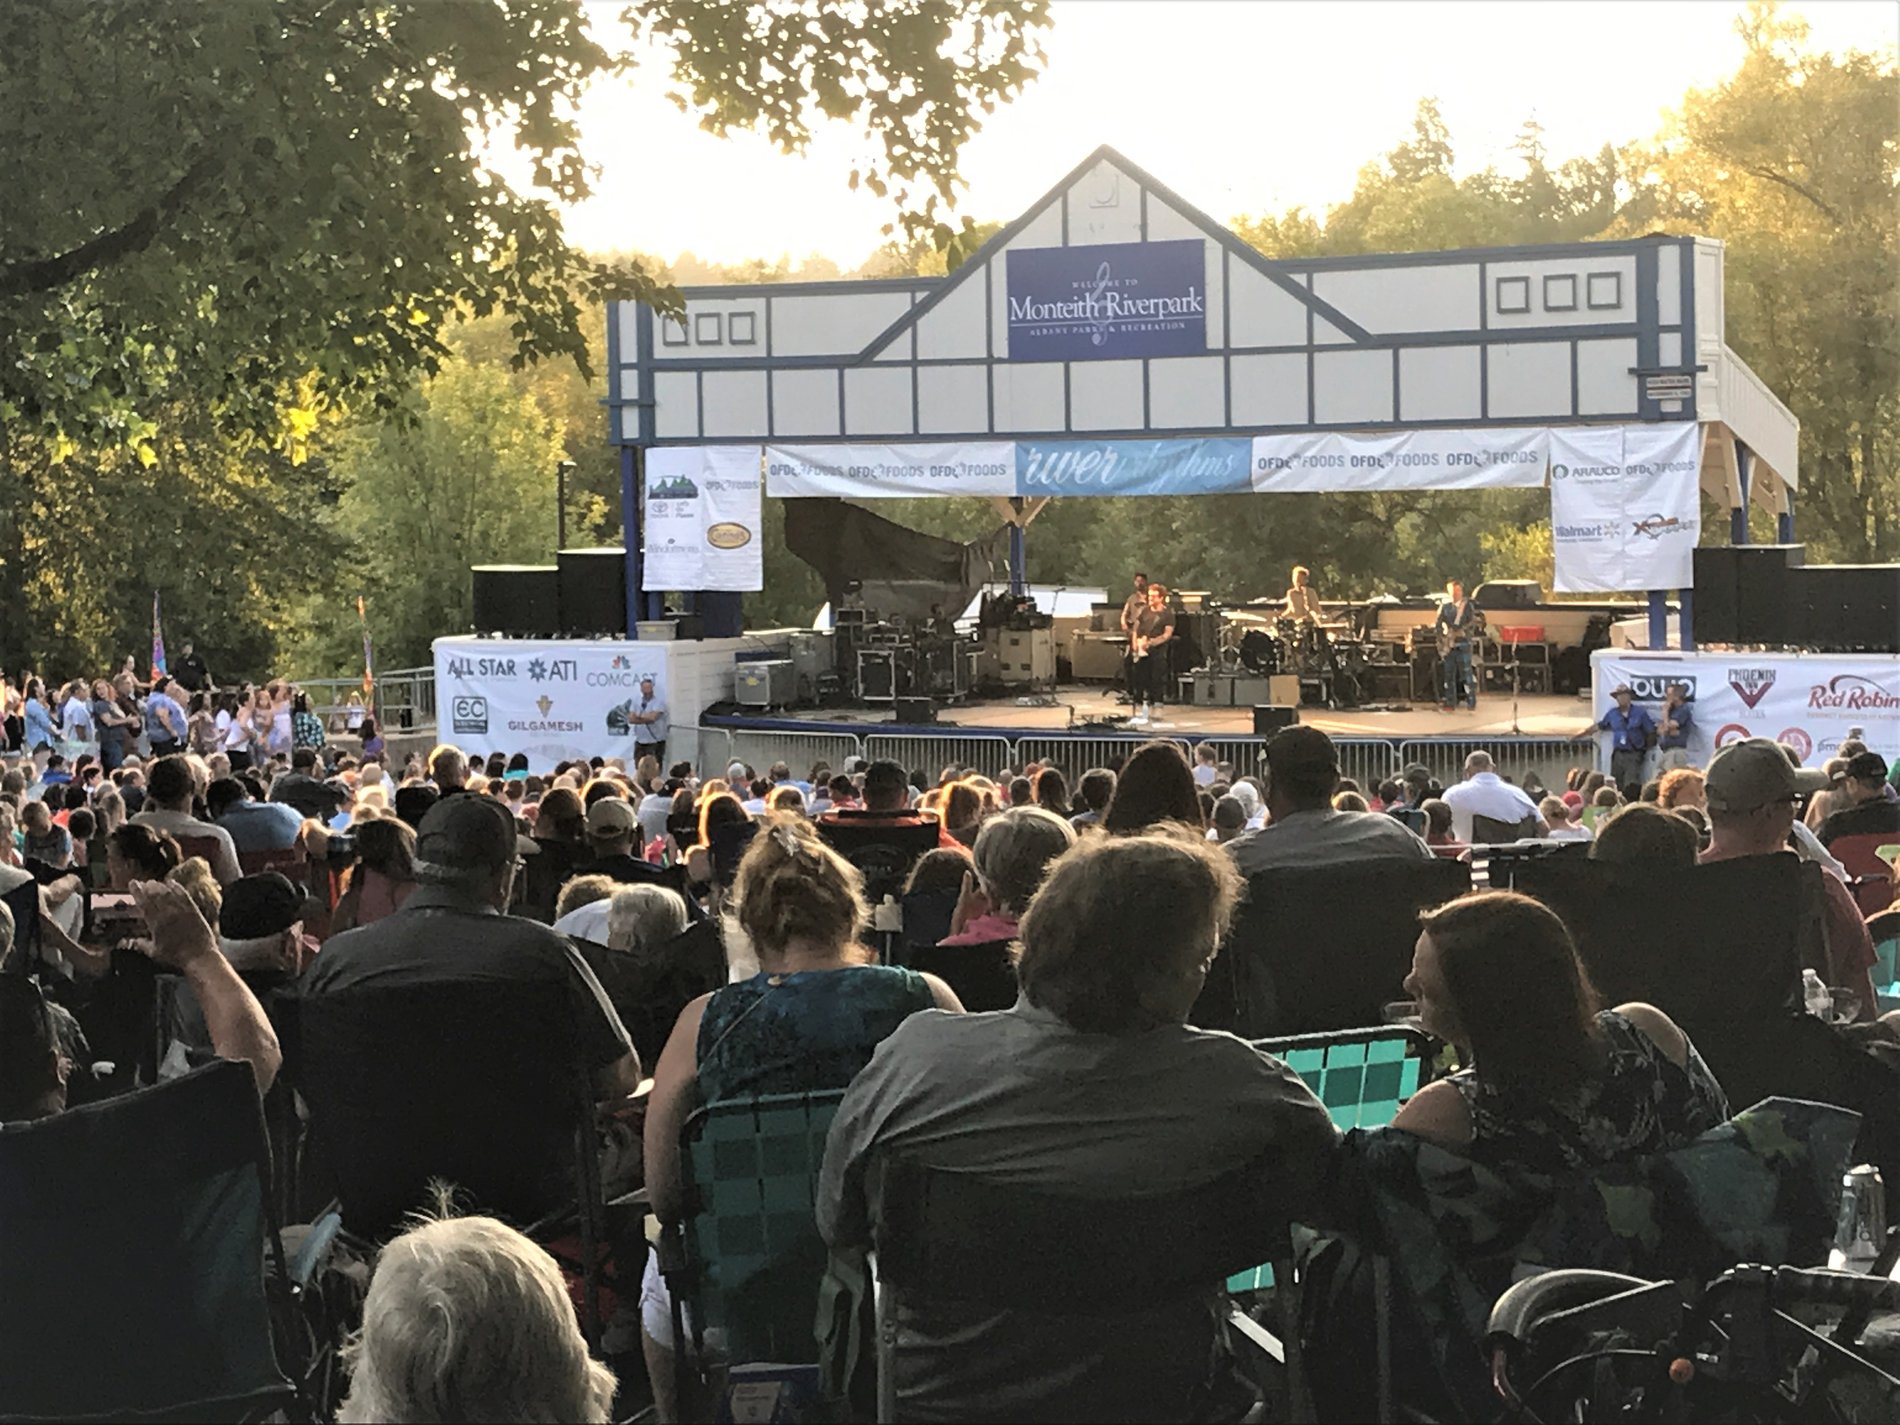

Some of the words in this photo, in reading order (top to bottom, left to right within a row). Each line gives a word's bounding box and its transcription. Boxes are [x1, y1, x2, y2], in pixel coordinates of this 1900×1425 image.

[1124, 278, 1138, 287] TO
[1009, 293, 1099, 321] Monteith
[1105, 286, 1203, 320] Riverpark
[1121, 321, 1186, 332] RECREATION
[1258, 456, 1285, 470] OFD
[1302, 454, 1345, 469] FOODS
[1350, 454, 1379, 468] OFD
[1395, 452, 1440, 467] FOODS
[1446, 452, 1473, 467] OFD
[1493, 450, 1539, 465] FOODS
[806, 464, 844, 476] FOODS
[885, 465, 925, 478] FOODS
[967, 463, 1007, 477] FOODS
[447, 658, 475, 677] ALL
[479, 658, 517, 676] STAR
[548, 660, 578, 681] ATI
[1728, 668, 1776, 681] PHOENIX
[1807, 684, 1847, 710] Red
[1847, 685, 1900, 711] Robin
[507, 720, 583, 732] GILGAMESH
